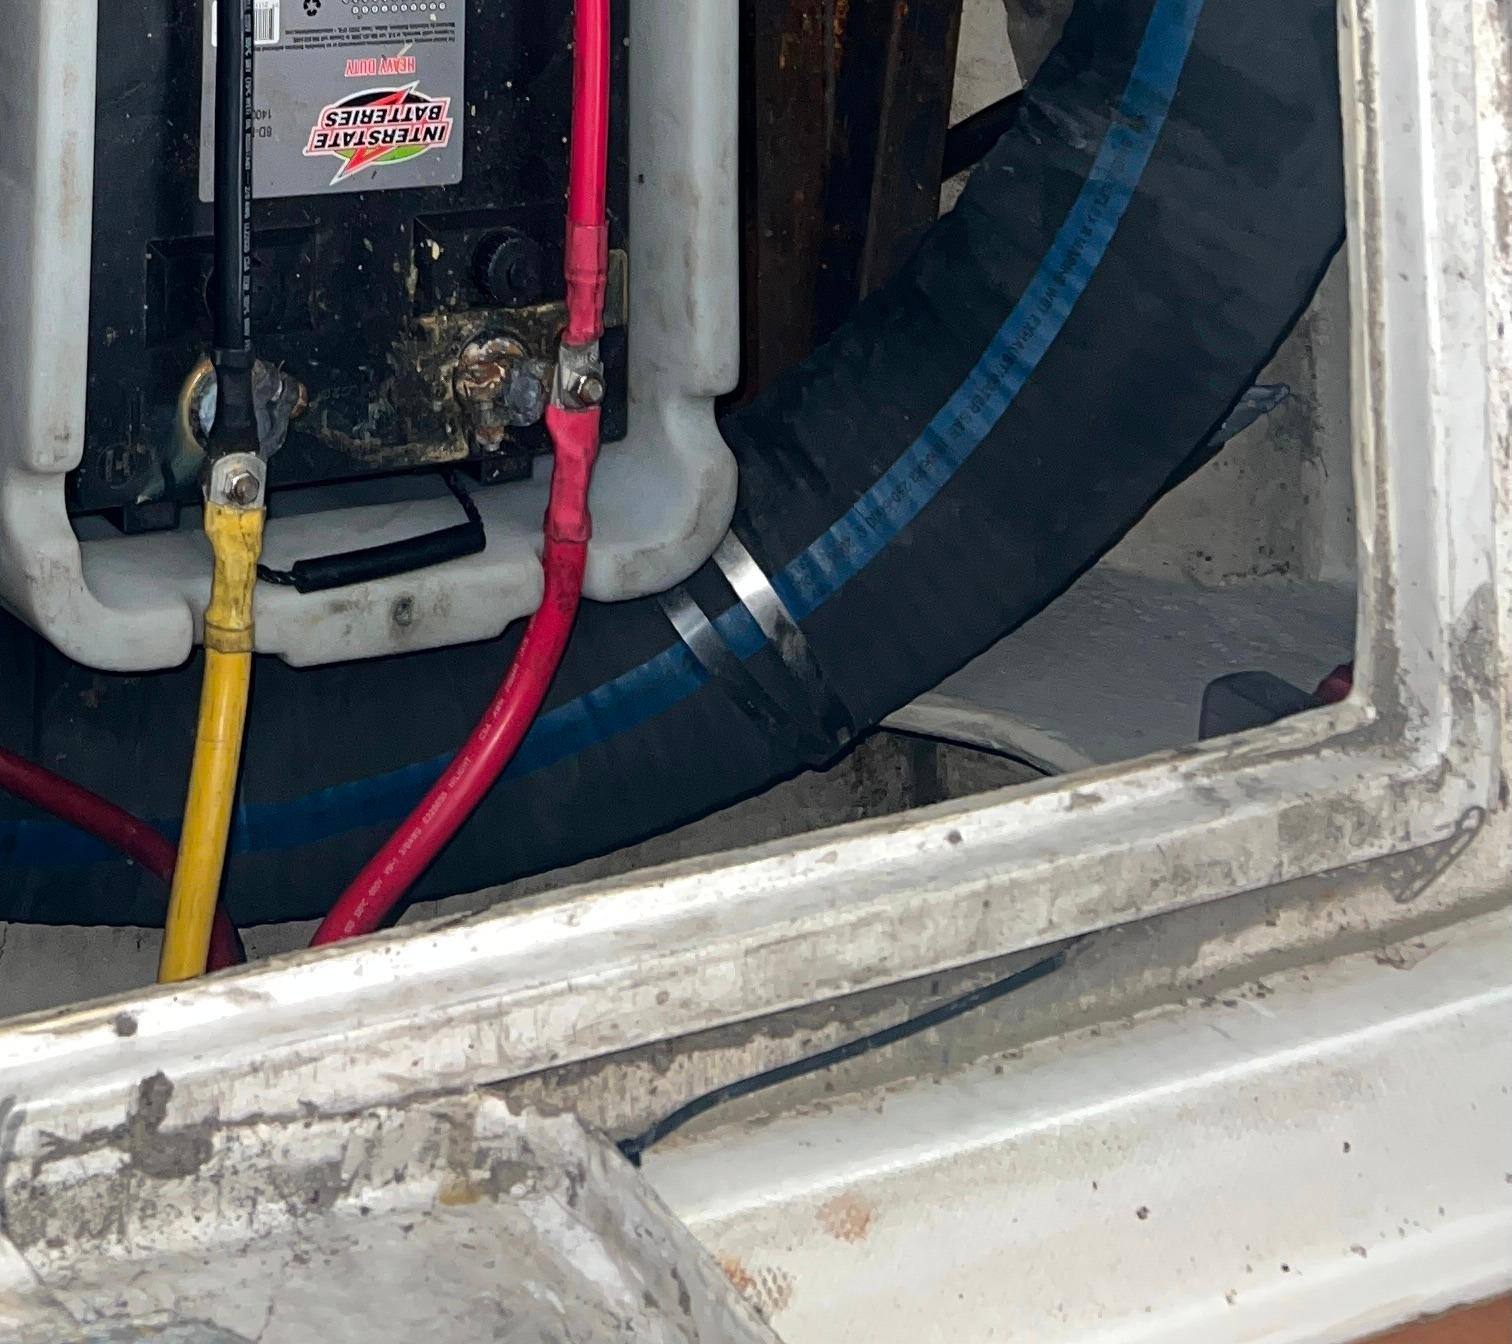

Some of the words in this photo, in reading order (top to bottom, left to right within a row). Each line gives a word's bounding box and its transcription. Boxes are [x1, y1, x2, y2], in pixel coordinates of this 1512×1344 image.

[345, 58, 376, 77] DUTY
[380, 56, 415, 74] HEAVY
[324, 104, 442, 128] BATTERIES
[314, 124, 446, 149] INTERSTATE
